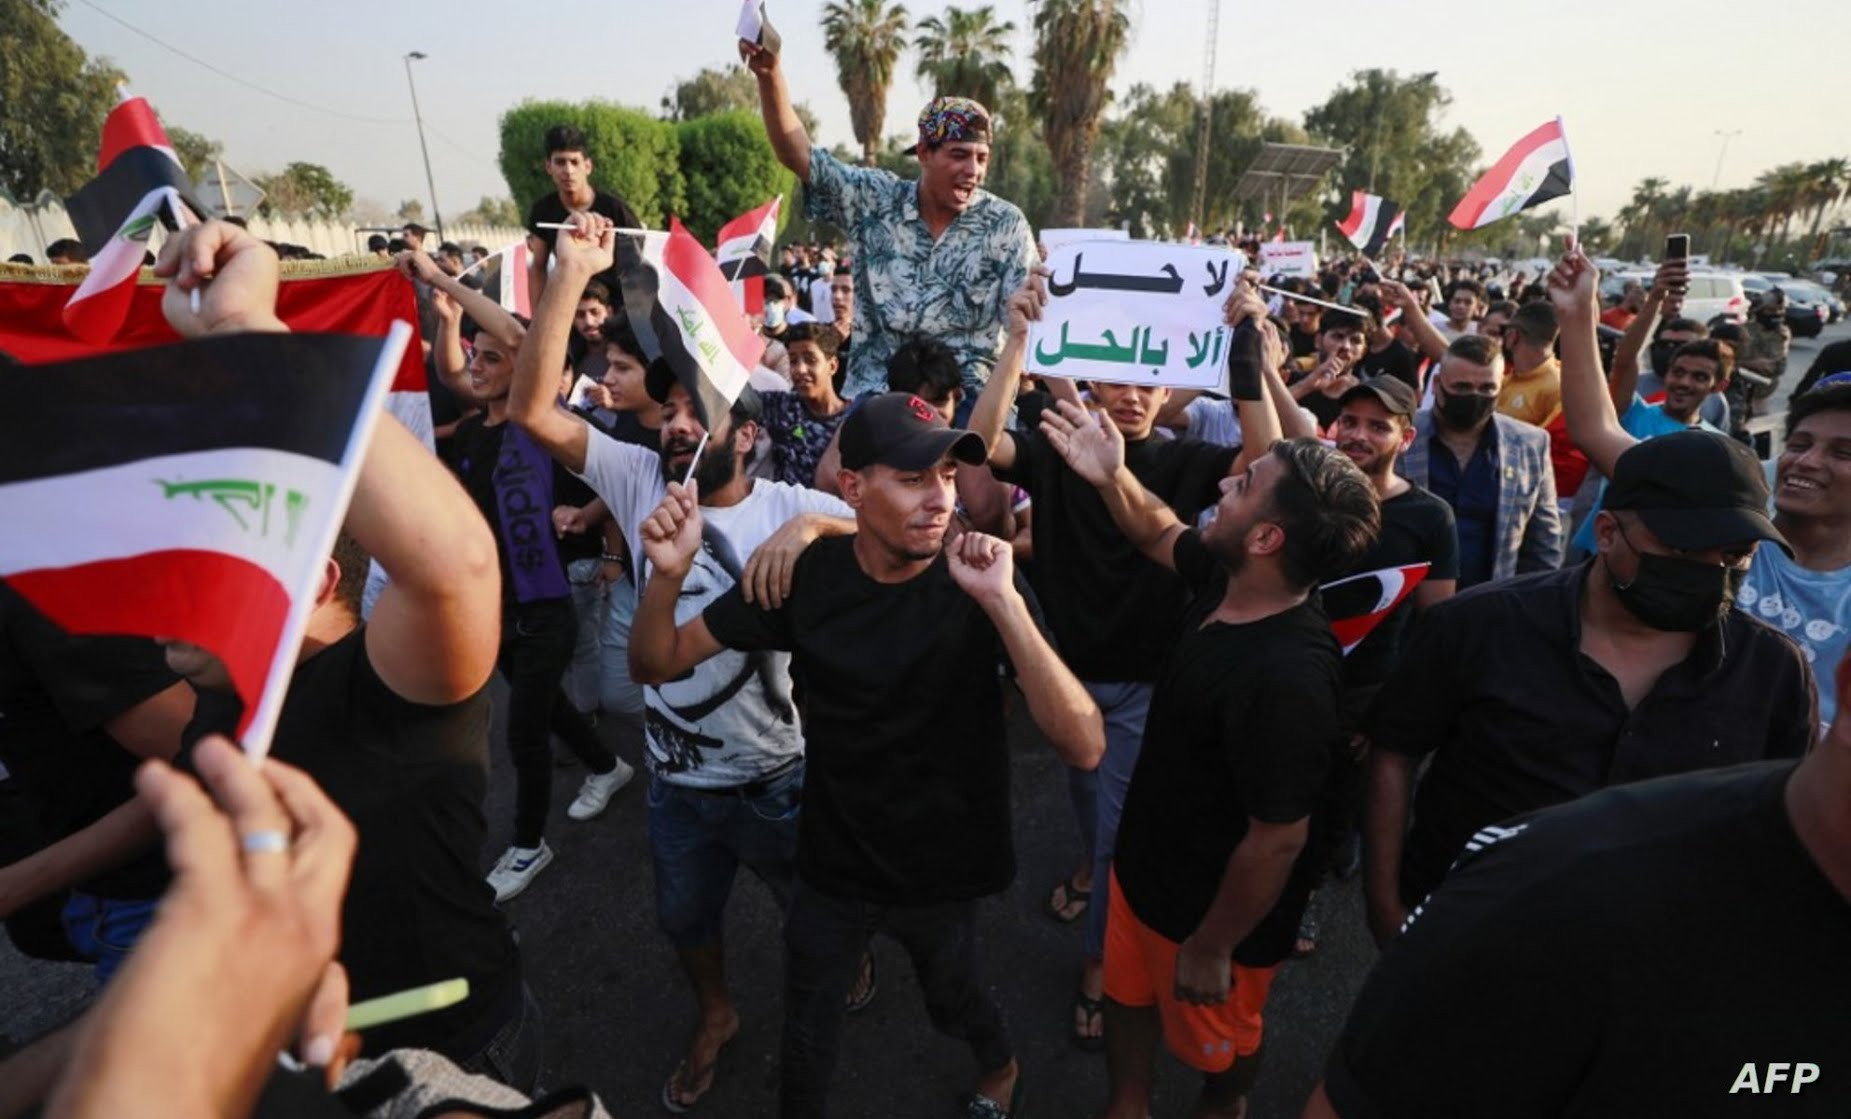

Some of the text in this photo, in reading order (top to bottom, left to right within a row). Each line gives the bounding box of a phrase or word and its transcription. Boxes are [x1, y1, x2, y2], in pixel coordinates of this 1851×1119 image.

[1047, 252, 1229, 298] لا حل
[1035, 320, 1224, 376] ألا بالحل
